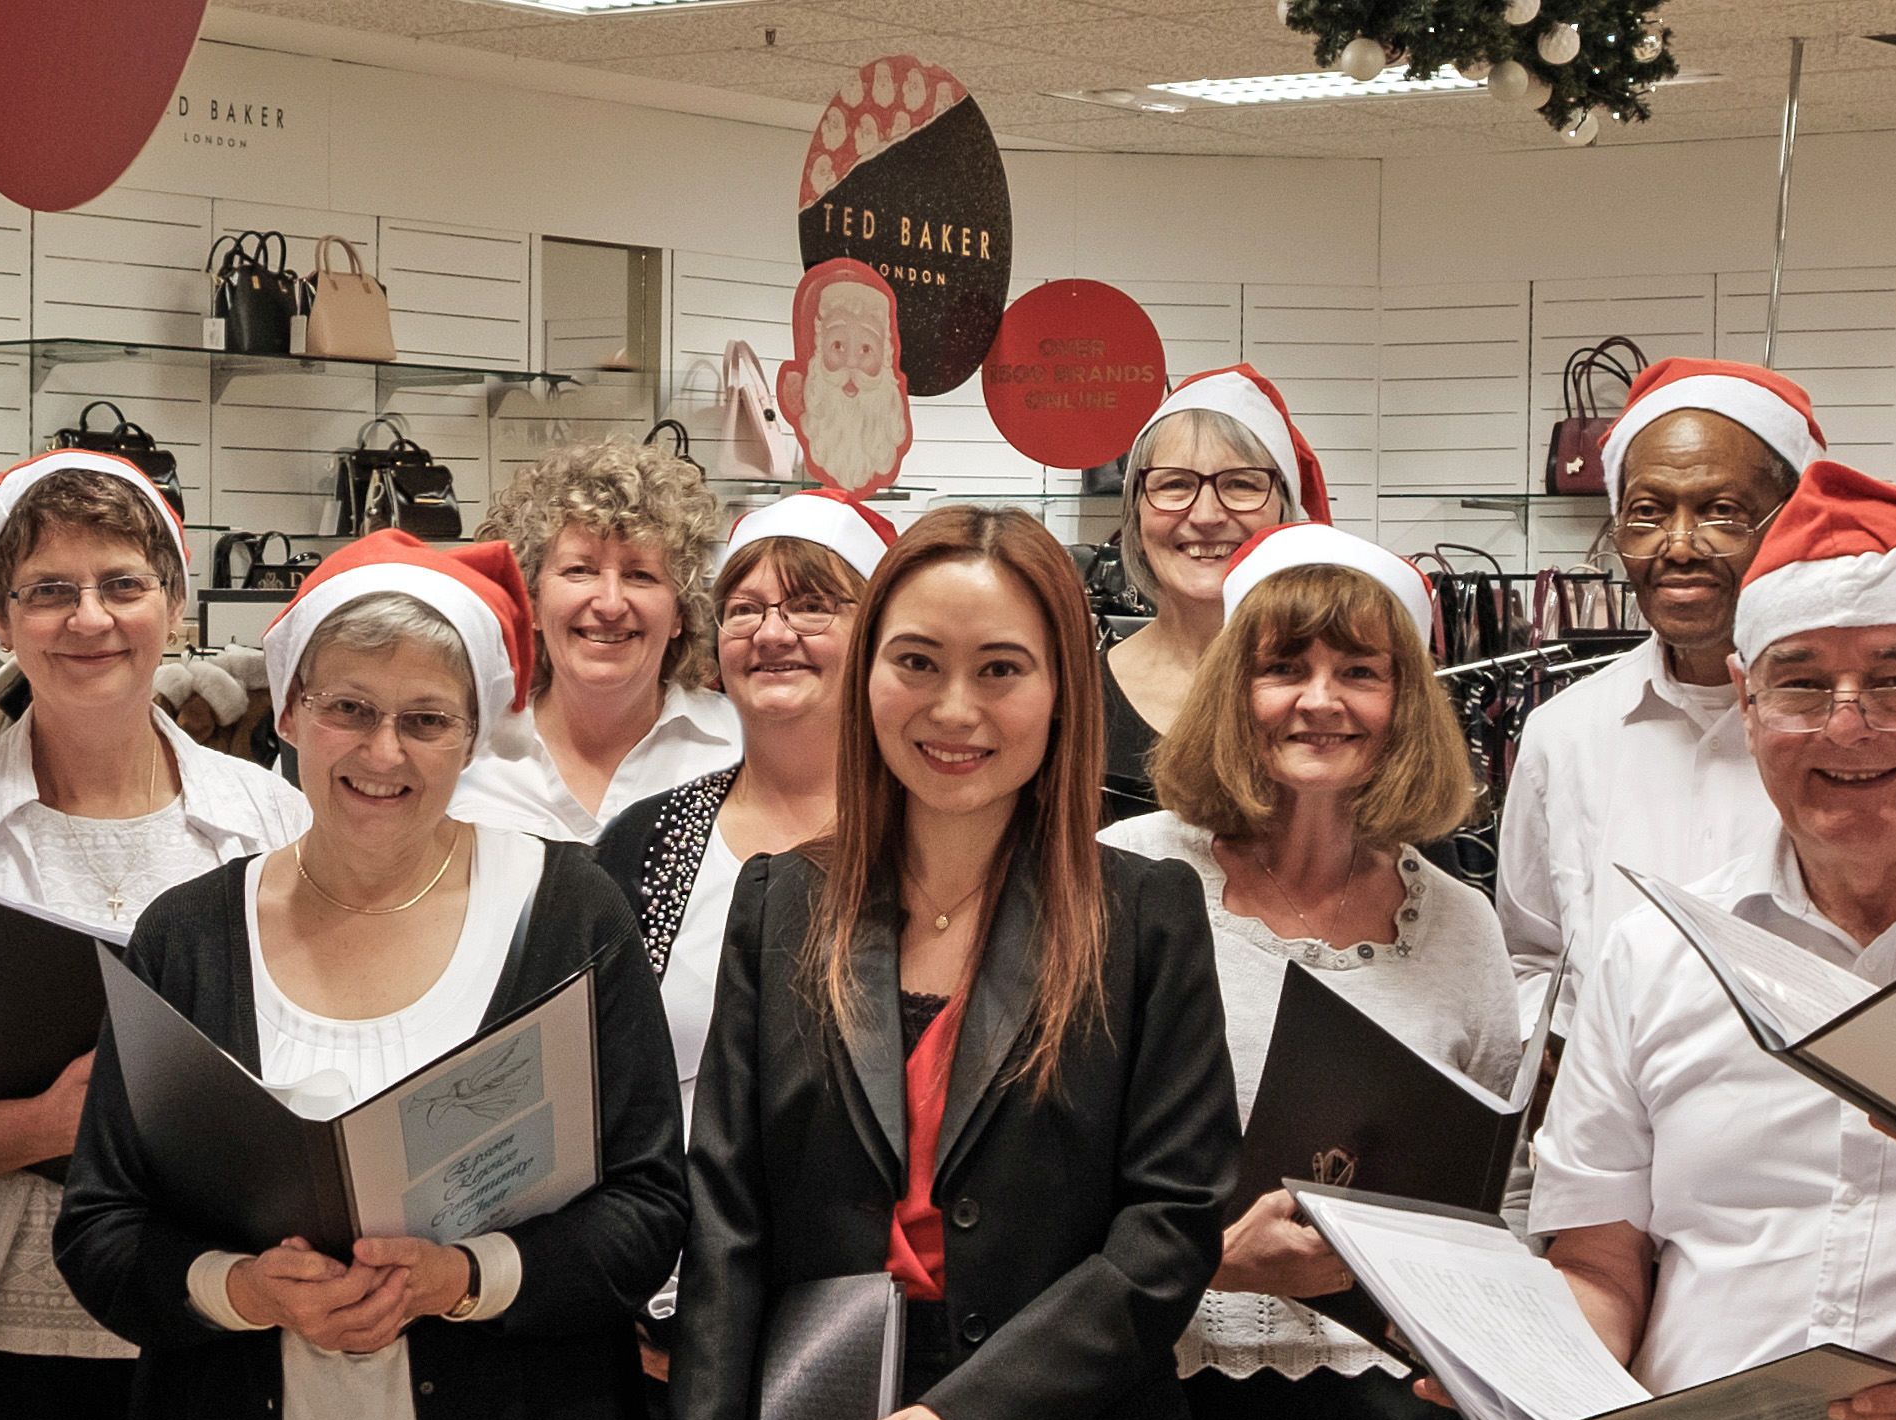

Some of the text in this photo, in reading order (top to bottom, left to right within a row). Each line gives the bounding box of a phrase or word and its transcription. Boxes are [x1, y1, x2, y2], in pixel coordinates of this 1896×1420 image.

[211, 99, 284, 129] BAKER
[184, 132, 247, 148] LONDON
[824, 203, 991, 260] TED BAKER
[1038, 337, 1106, 358] OVER
[1054, 364, 1156, 384] BRANDS
[1024, 389, 1119, 410] ONLINE
[443, 1133, 515, 1183] Epsom
[444, 1148, 519, 1202] Rejoice
[431, 1156, 534, 1228] Community
[456, 1186, 511, 1227] Choir
